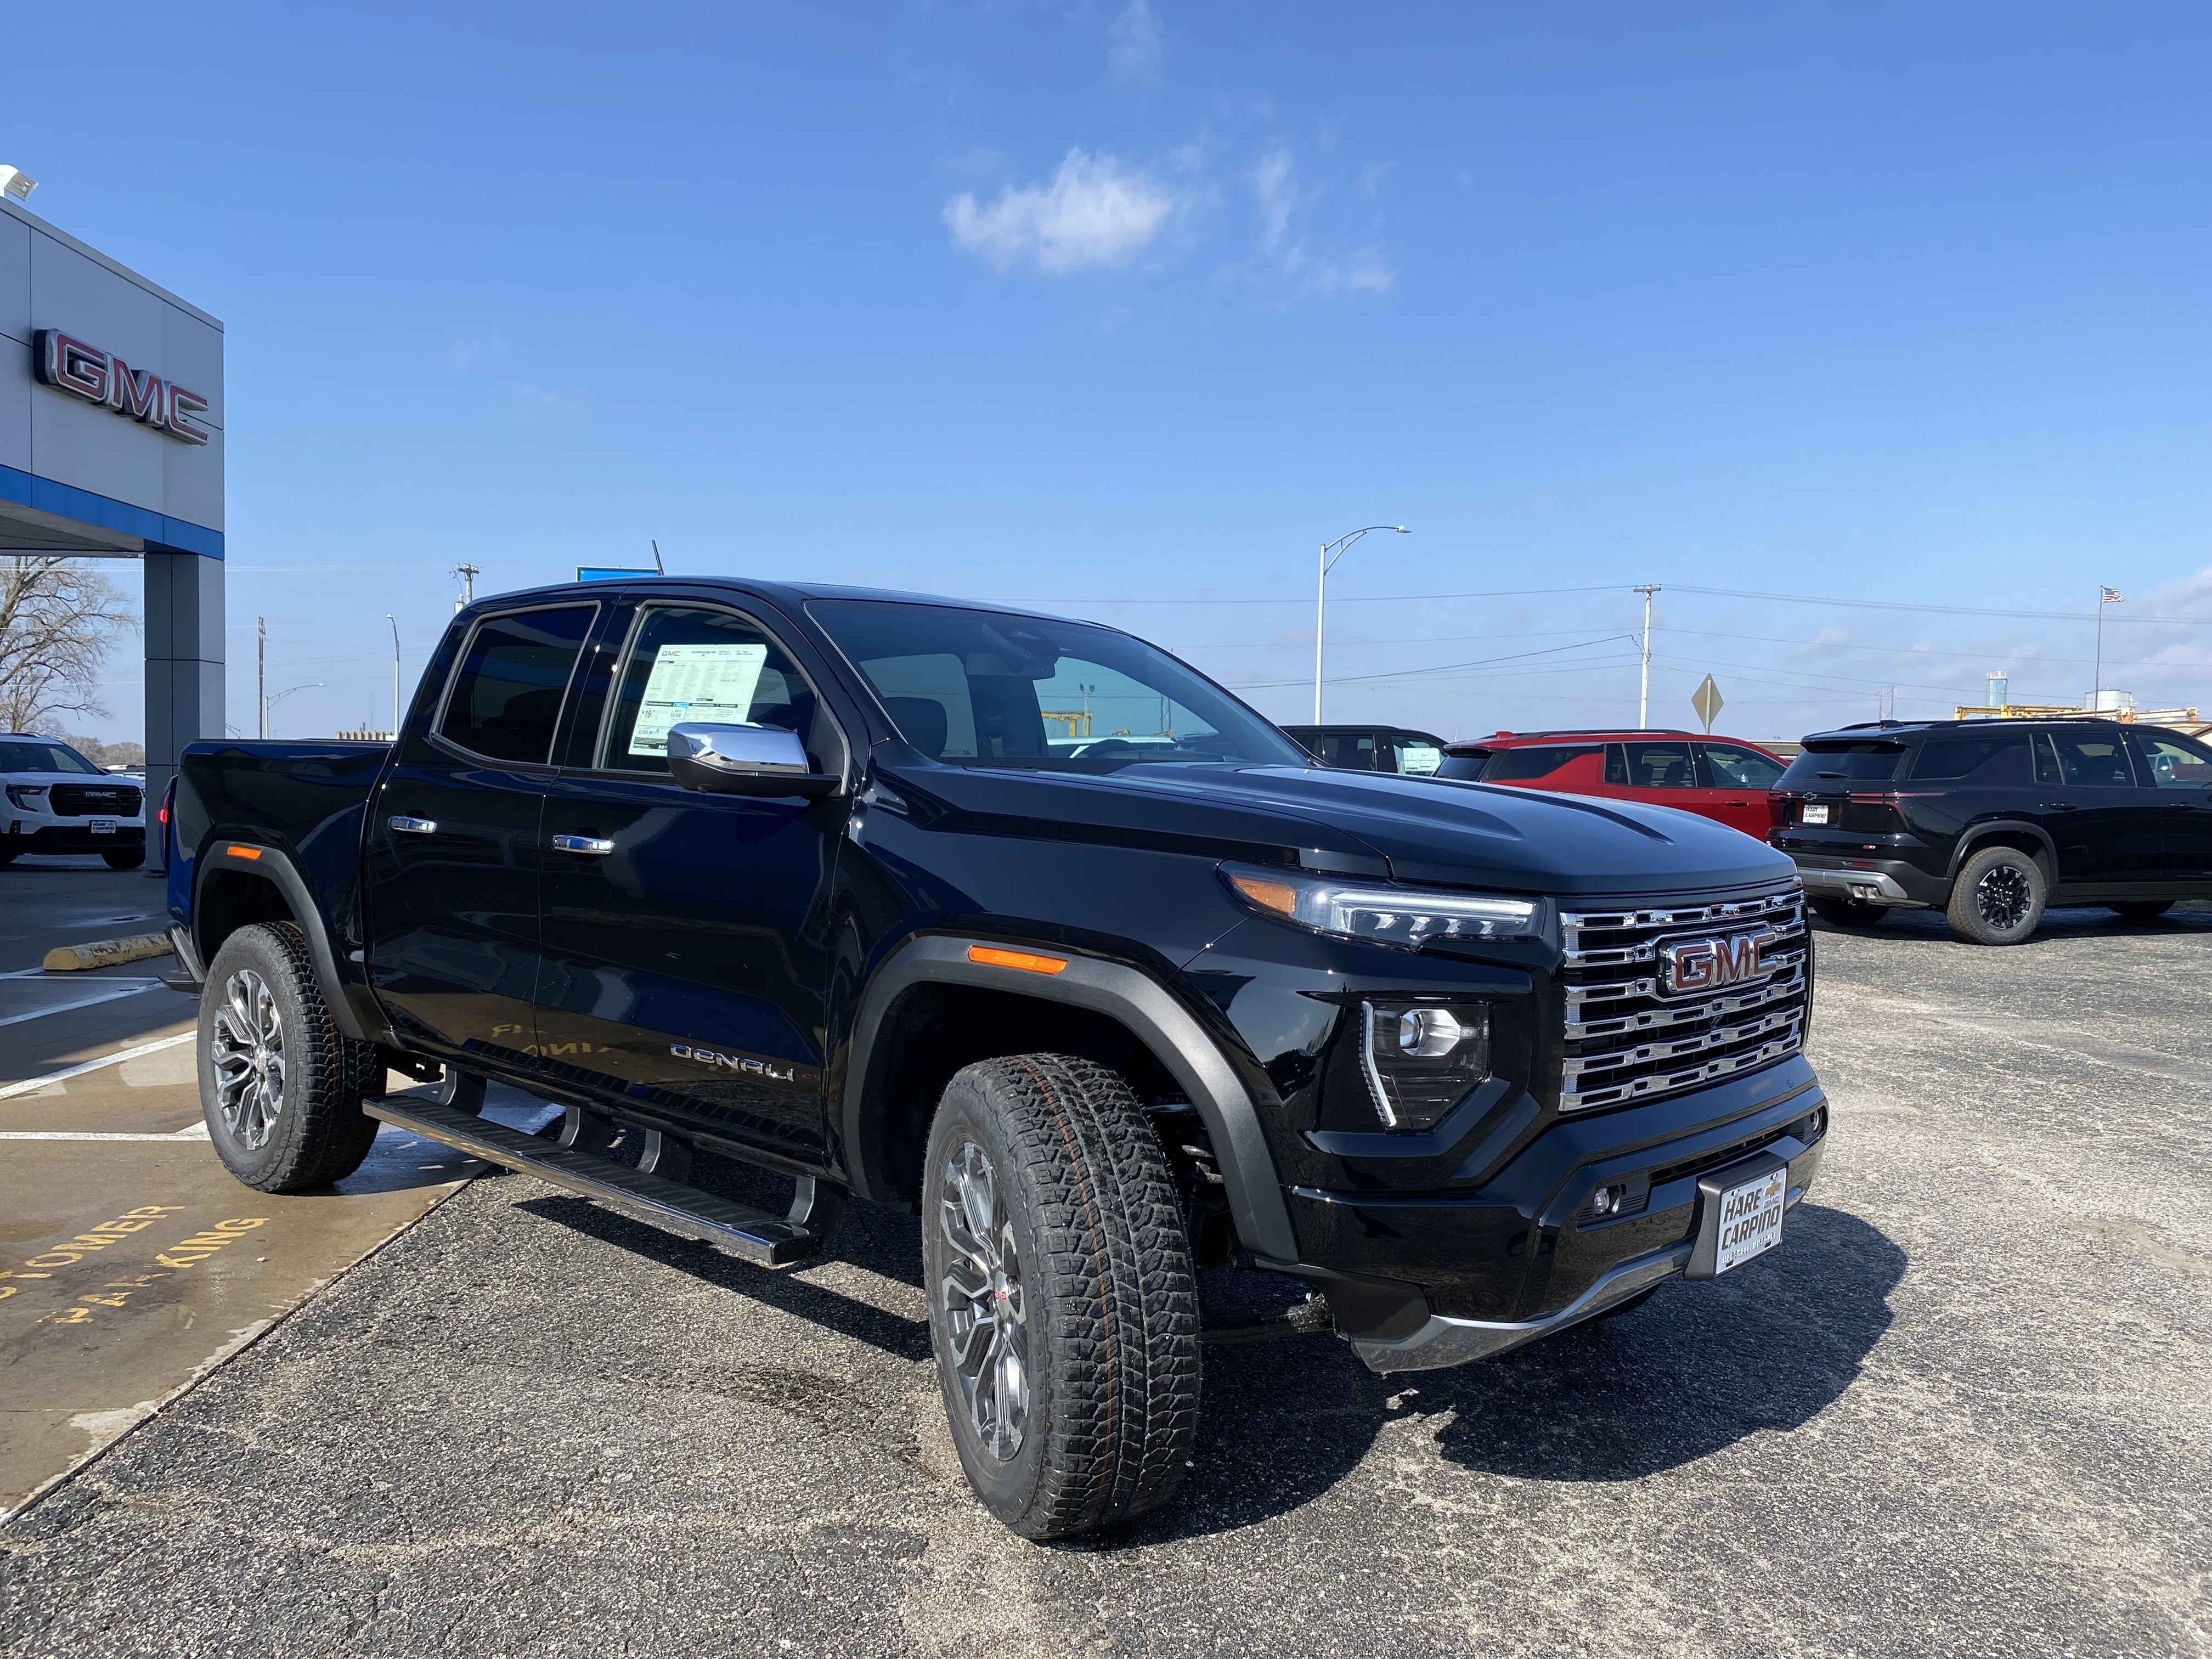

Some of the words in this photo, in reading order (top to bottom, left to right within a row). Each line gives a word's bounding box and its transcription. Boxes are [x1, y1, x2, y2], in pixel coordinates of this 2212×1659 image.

[34, 328, 209, 446] GMC
[1668, 928, 1777, 992] GMC
[670, 1042, 794, 1082] DENALI
[1723, 1188, 1762, 1224] HARE
[1764, 1195, 1779, 1208] GMC
[1721, 1204, 1780, 1250] CARPINO
